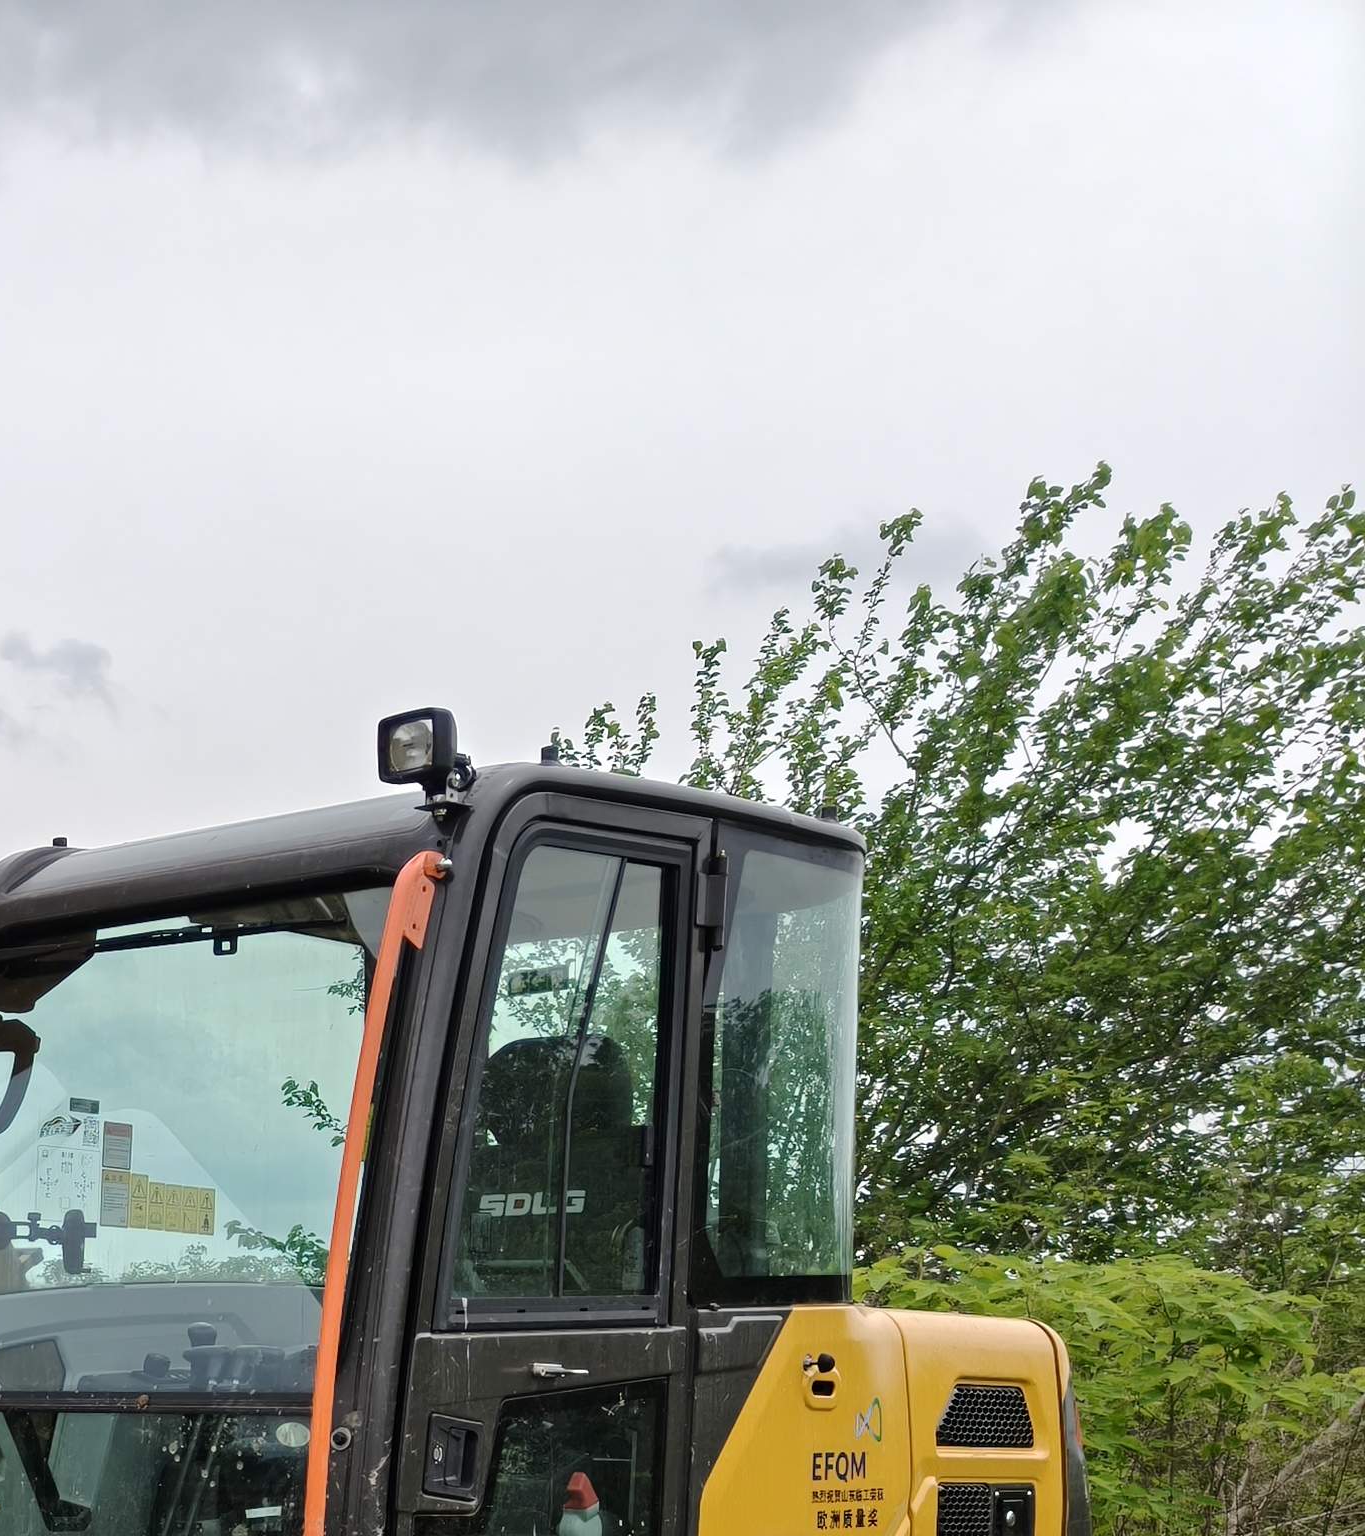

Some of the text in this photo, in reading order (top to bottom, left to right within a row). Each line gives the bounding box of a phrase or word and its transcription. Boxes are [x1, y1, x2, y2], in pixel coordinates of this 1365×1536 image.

[478, 1190, 586, 1217] SDLG
[812, 1451, 866, 1483] EFQM
[817, 1508, 878, 1530] 欧洲质量奖
